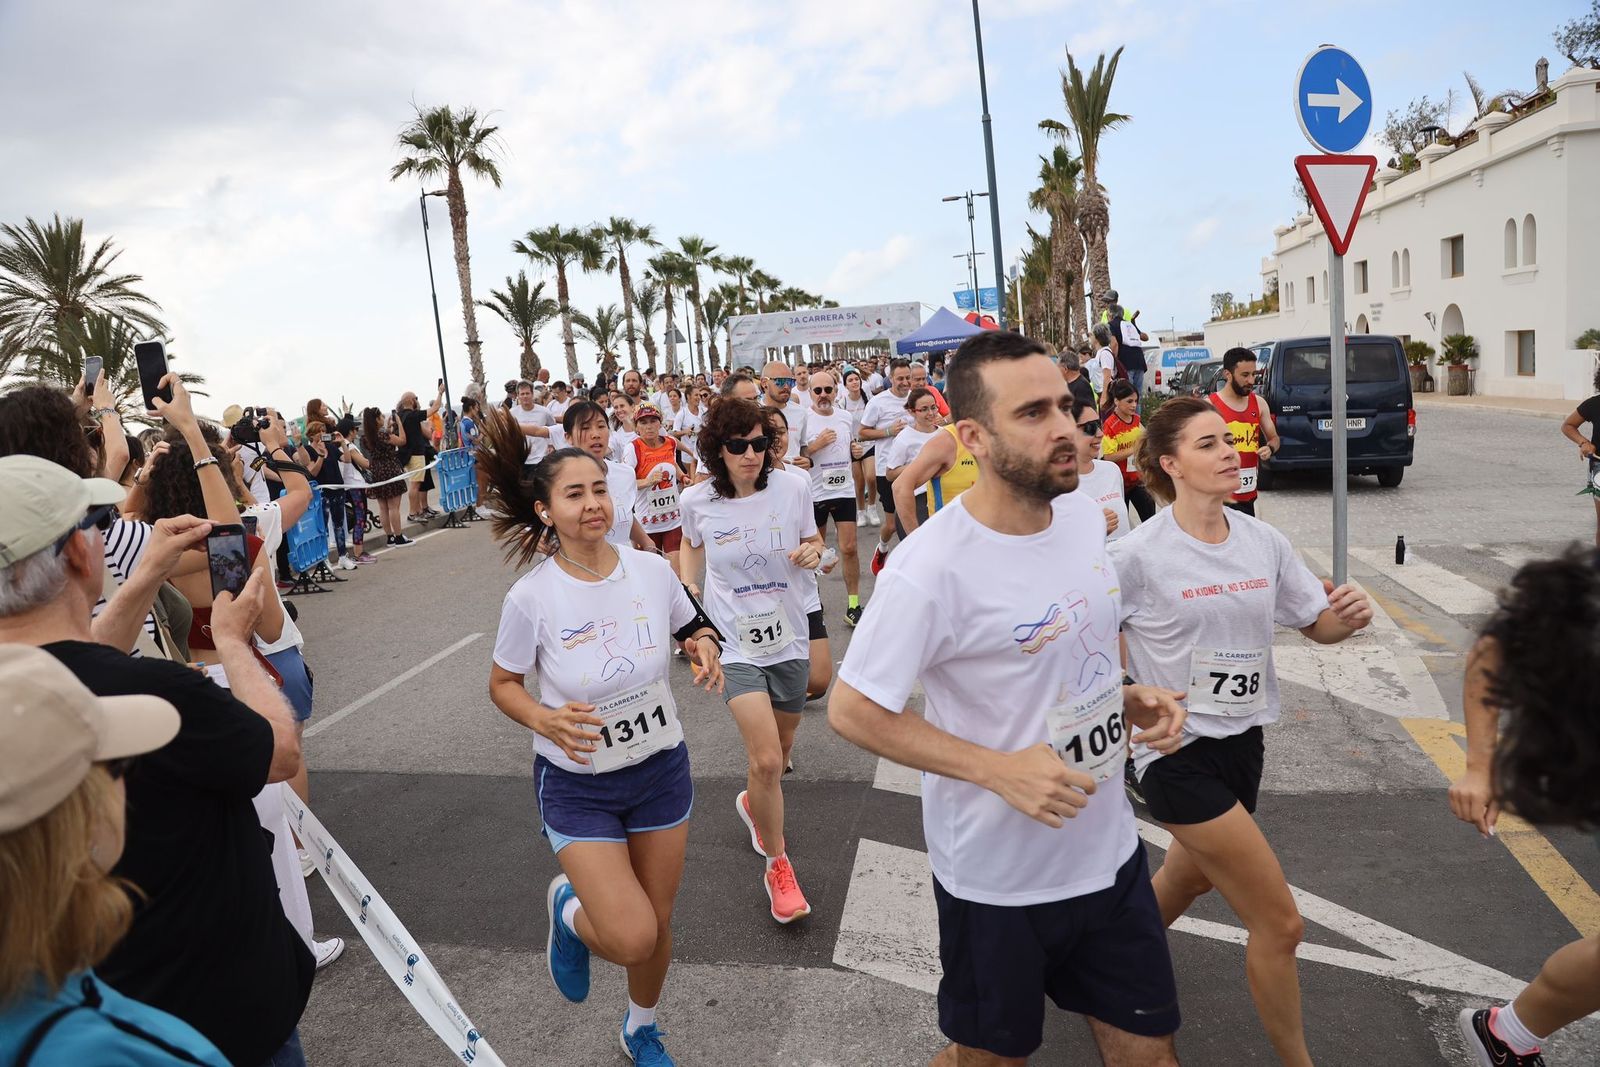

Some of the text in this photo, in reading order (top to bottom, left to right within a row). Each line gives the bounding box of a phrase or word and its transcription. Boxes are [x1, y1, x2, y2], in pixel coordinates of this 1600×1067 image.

[789, 312, 858, 325] 3A CARRERA 5K
[1347, 419, 1363, 428] HNR
[828, 475, 846, 485] 269
[1240, 476, 1254, 486] 37
[651, 494, 676, 508] 1071
[1182, 588, 1194, 600] NO
[1227, 582, 1239, 593] NO
[1239, 578, 1269, 591] EXCUSES
[749, 619, 783, 644] 315
[1209, 671, 1260, 697] 738
[609, 693, 640, 709] CARRERA
[1073, 704, 1086, 714] 3A
[1086, 686, 1116, 708] CARRERA
[599, 704, 667, 749] 1311
